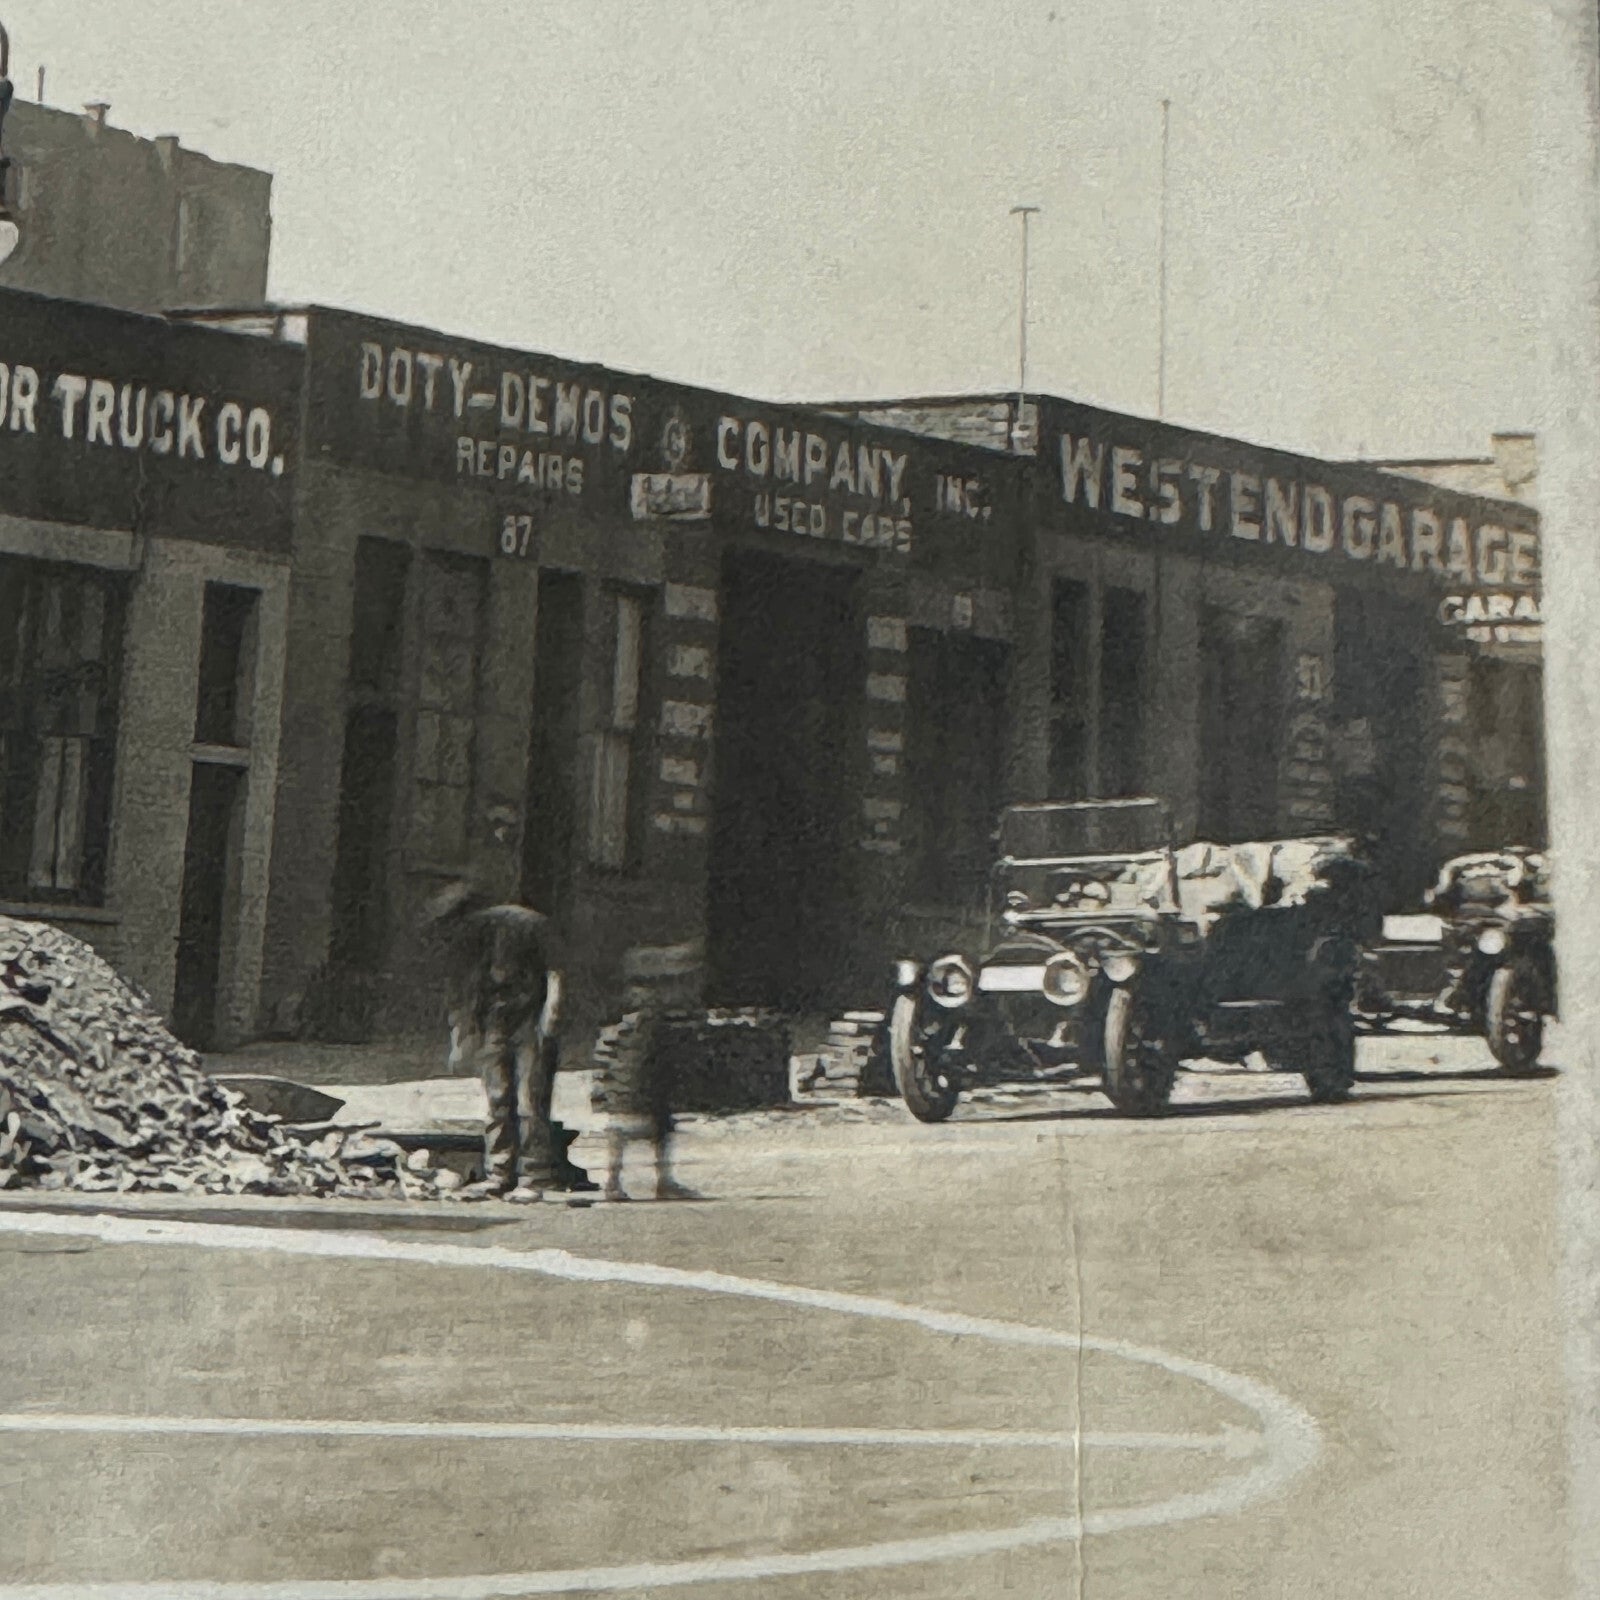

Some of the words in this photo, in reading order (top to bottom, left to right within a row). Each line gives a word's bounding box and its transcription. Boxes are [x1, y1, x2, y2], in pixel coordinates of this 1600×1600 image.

[51, 374, 207, 458] TRUCK
[217, 402, 285, 477] CO.
[457, 437, 584, 496] REPAIRS
[754, 494, 826, 537] USED
[842, 511, 912, 554] CARS
[1060, 433, 1221, 531] WEST
[1231, 472, 1332, 553] END
[1341, 496, 1540, 586] GARAGE
[1437, 593, 1541, 627] GARA
